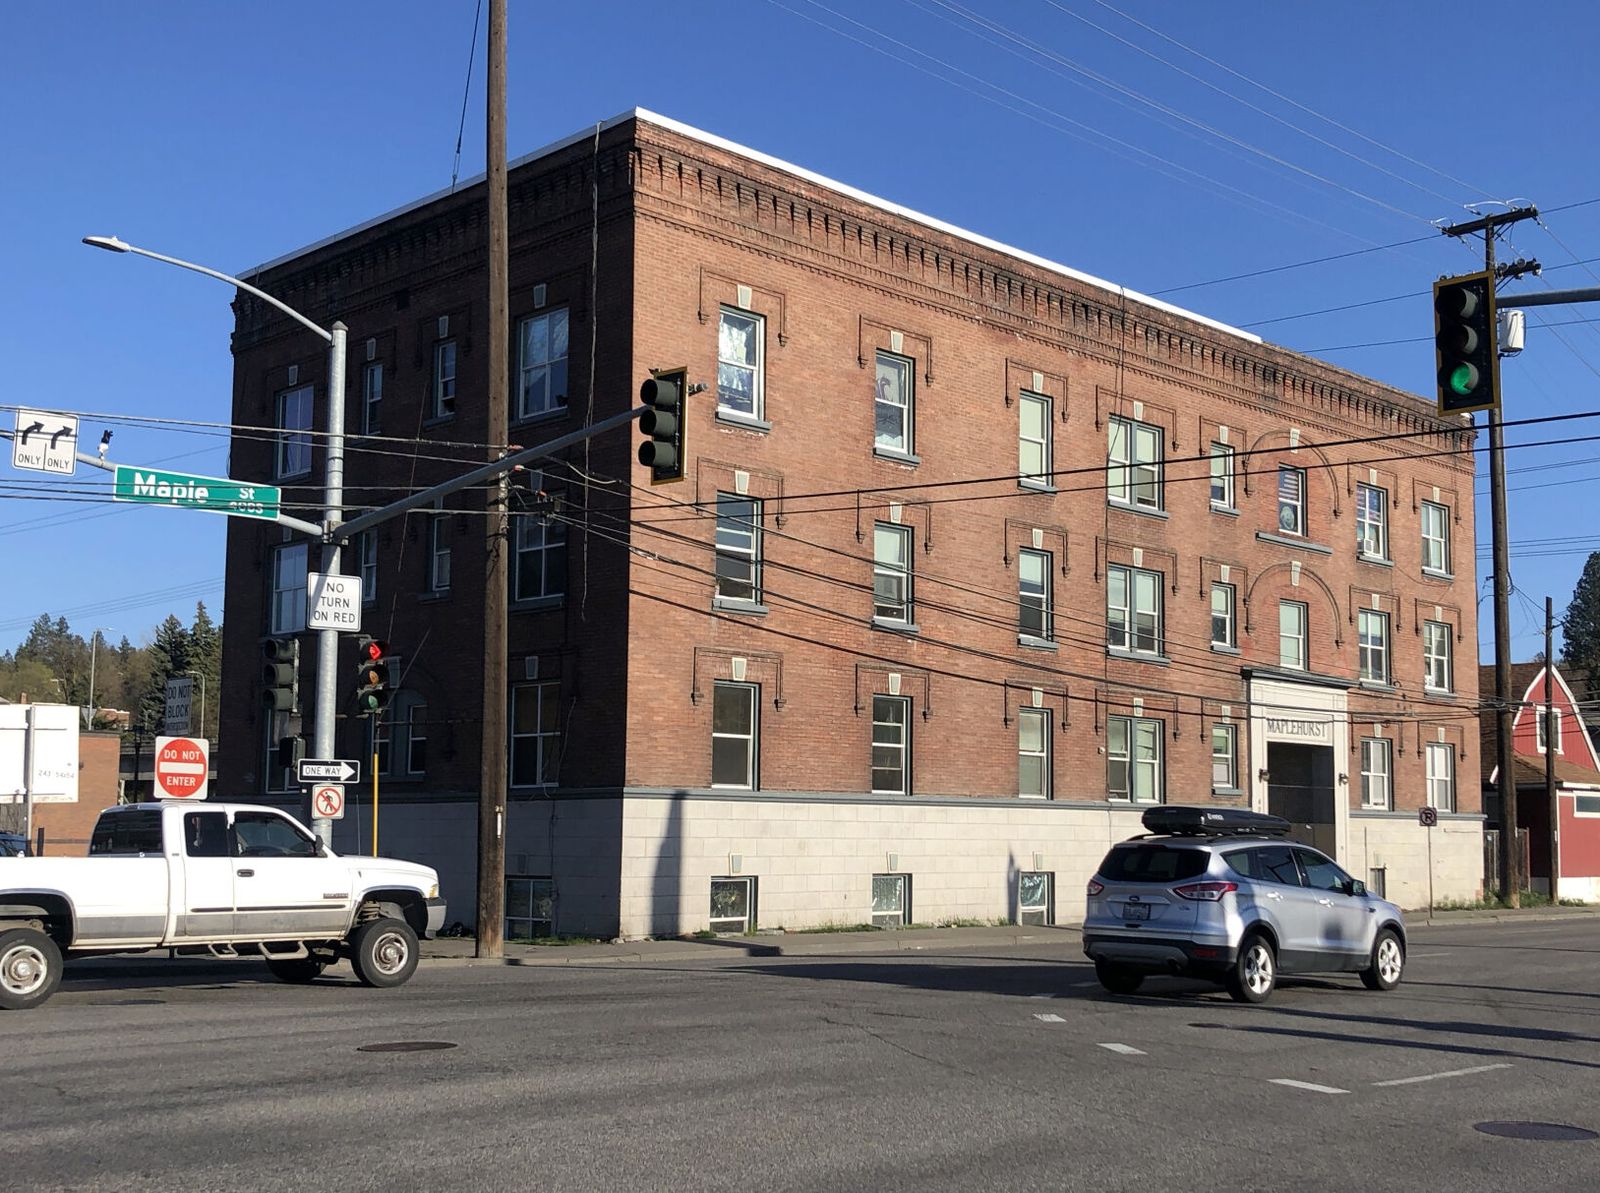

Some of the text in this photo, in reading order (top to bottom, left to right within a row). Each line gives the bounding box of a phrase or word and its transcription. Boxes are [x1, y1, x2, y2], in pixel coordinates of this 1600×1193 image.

[18, 453, 41, 465] ONLY
[47, 457, 70, 469] ONLY
[134, 472, 255, 503] Maple St
[326, 582, 344, 593] NO
[320, 595, 350, 608] TURN
[313, 610, 356, 623] ON RED
[168, 684, 191, 700] DO NOT
[167, 704, 189, 718] BLOCK
[1266, 718, 1326, 738] MAPLEHURST
[164, 749, 201, 761] DO NOT
[304, 766, 341, 776] ONE WAY
[166, 775, 196, 787] ENTER
